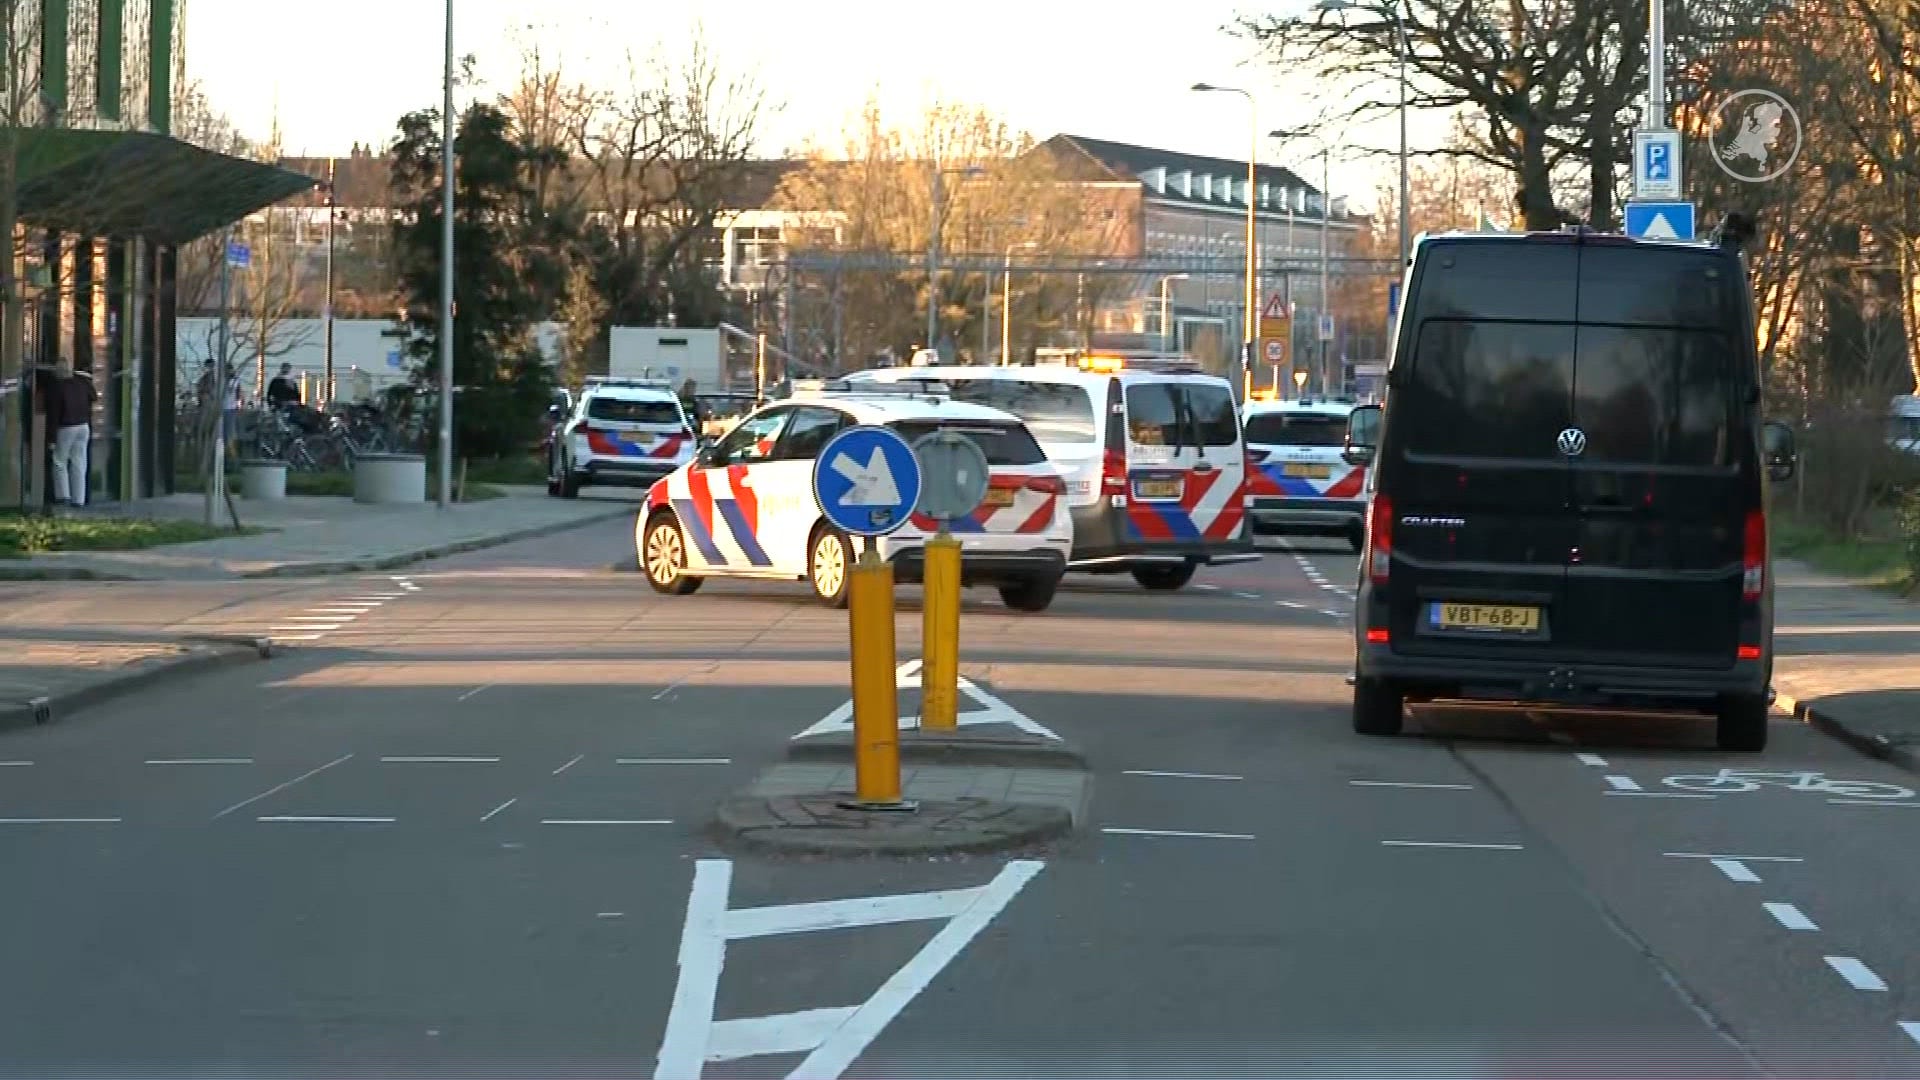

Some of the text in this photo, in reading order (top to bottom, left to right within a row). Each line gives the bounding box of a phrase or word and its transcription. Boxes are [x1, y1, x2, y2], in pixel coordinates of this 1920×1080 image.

[1650, 146, 1664, 165] P
[1401, 516, 1466, 527] CRAFTER
[1446, 606, 1529, 626] VBT-68-J
